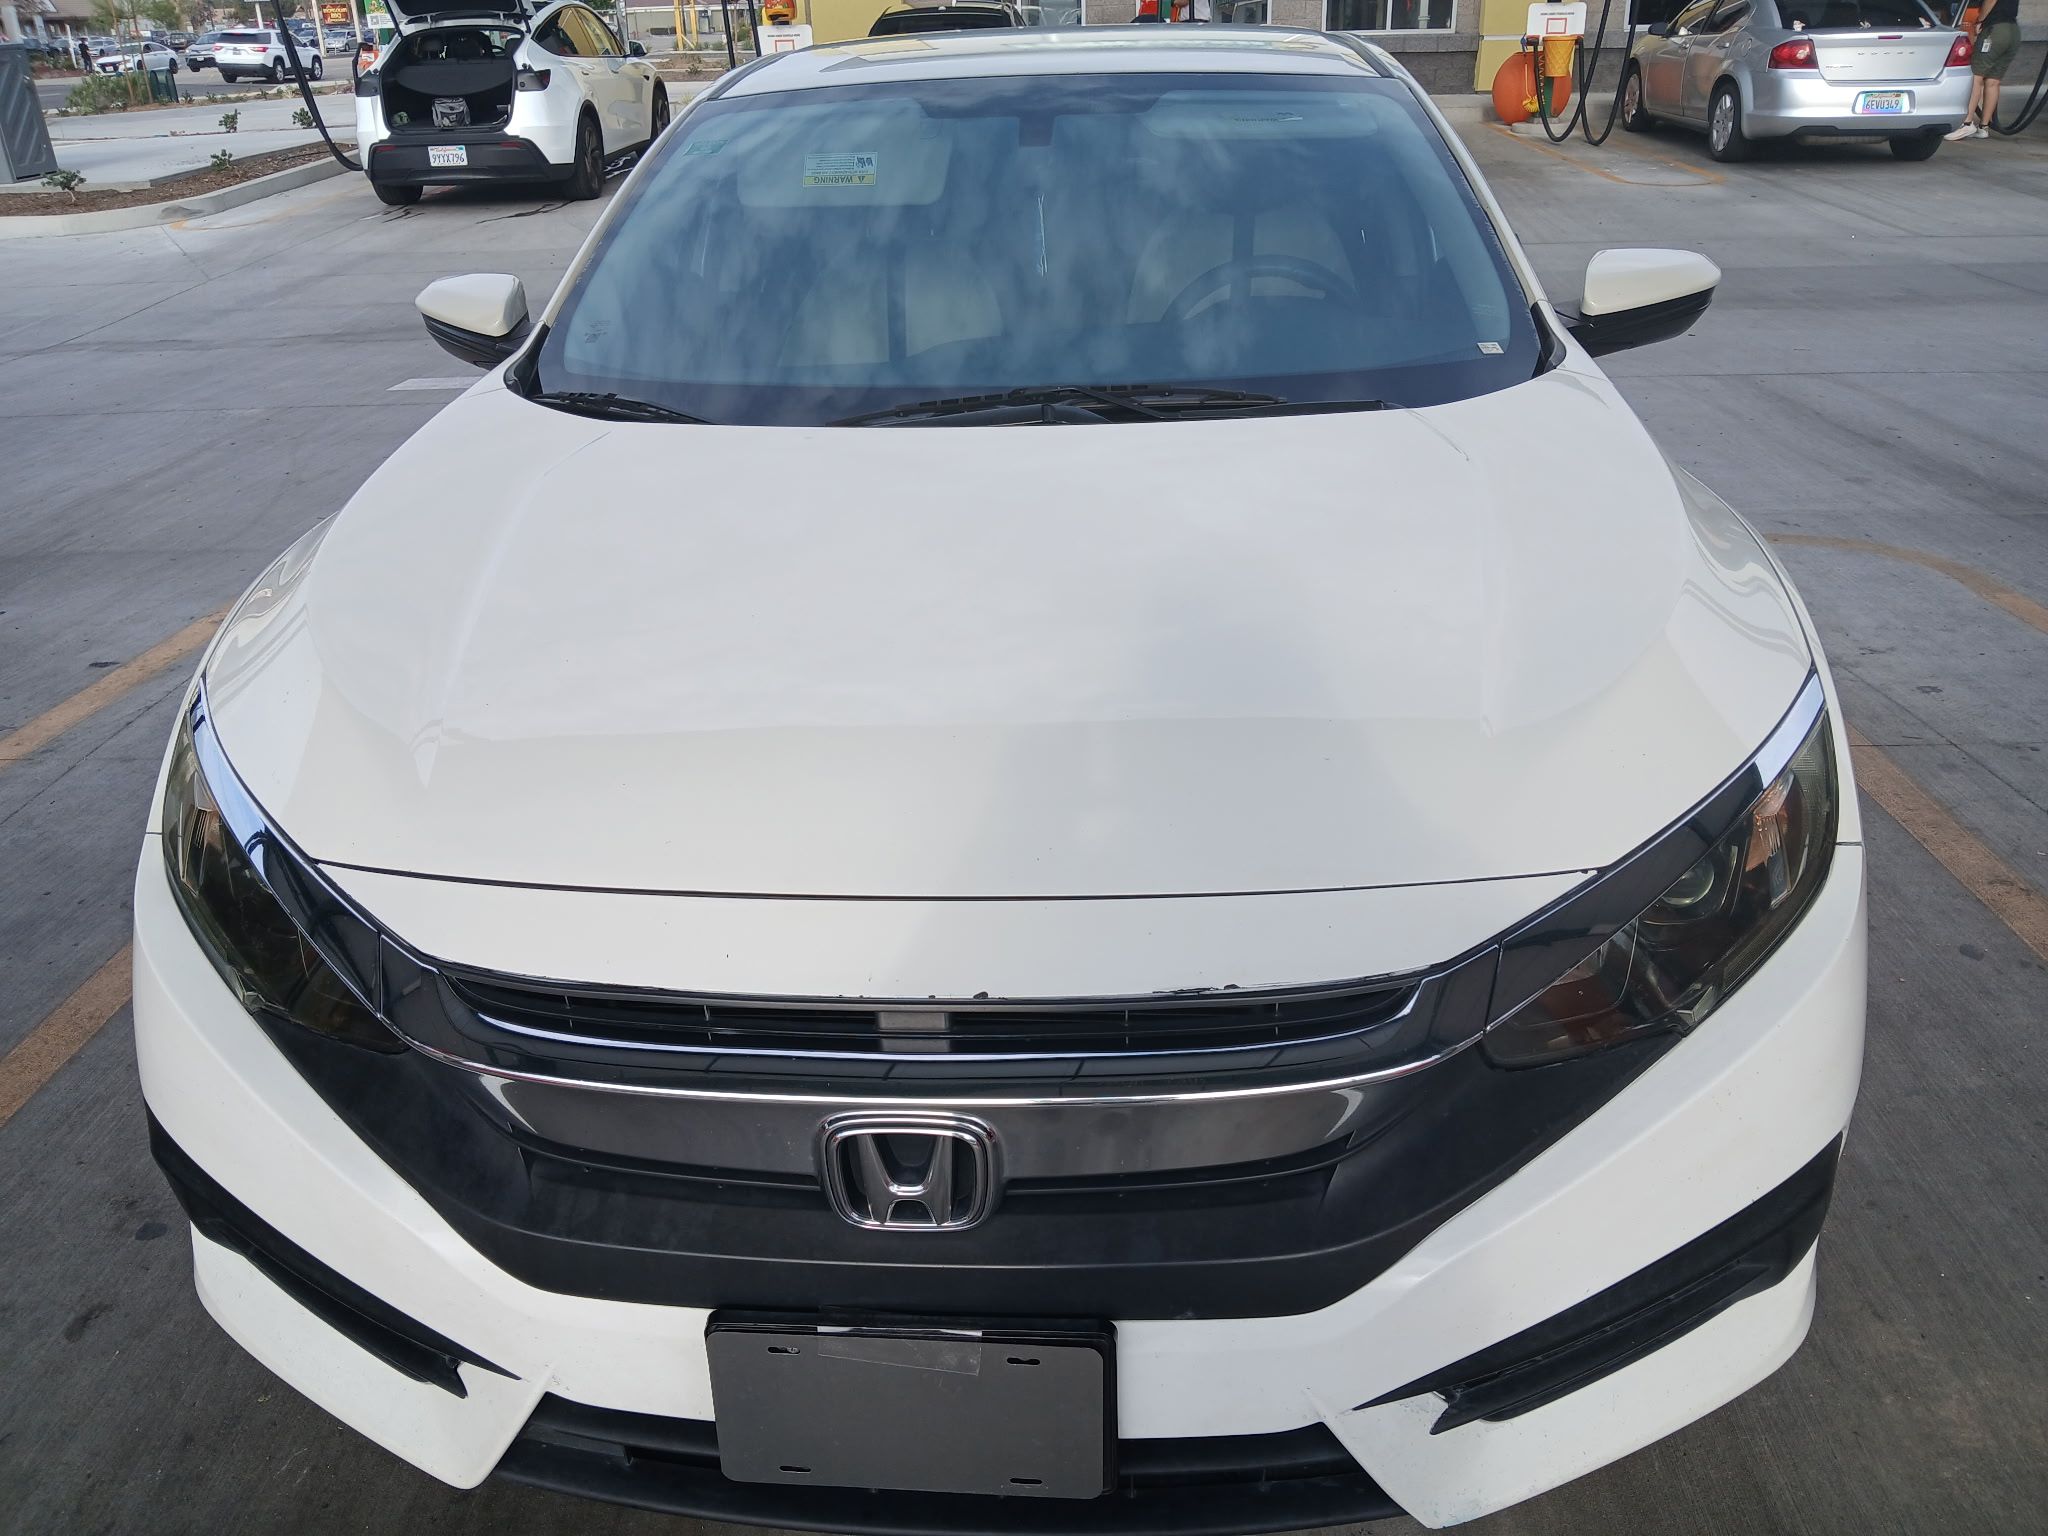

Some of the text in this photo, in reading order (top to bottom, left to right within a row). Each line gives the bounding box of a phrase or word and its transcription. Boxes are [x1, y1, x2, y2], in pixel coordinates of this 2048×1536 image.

[1865, 99, 1900, 110] 6EVU349
[432, 153, 465, 163] 9YYX796
[814, 175, 853, 184] WARNING
